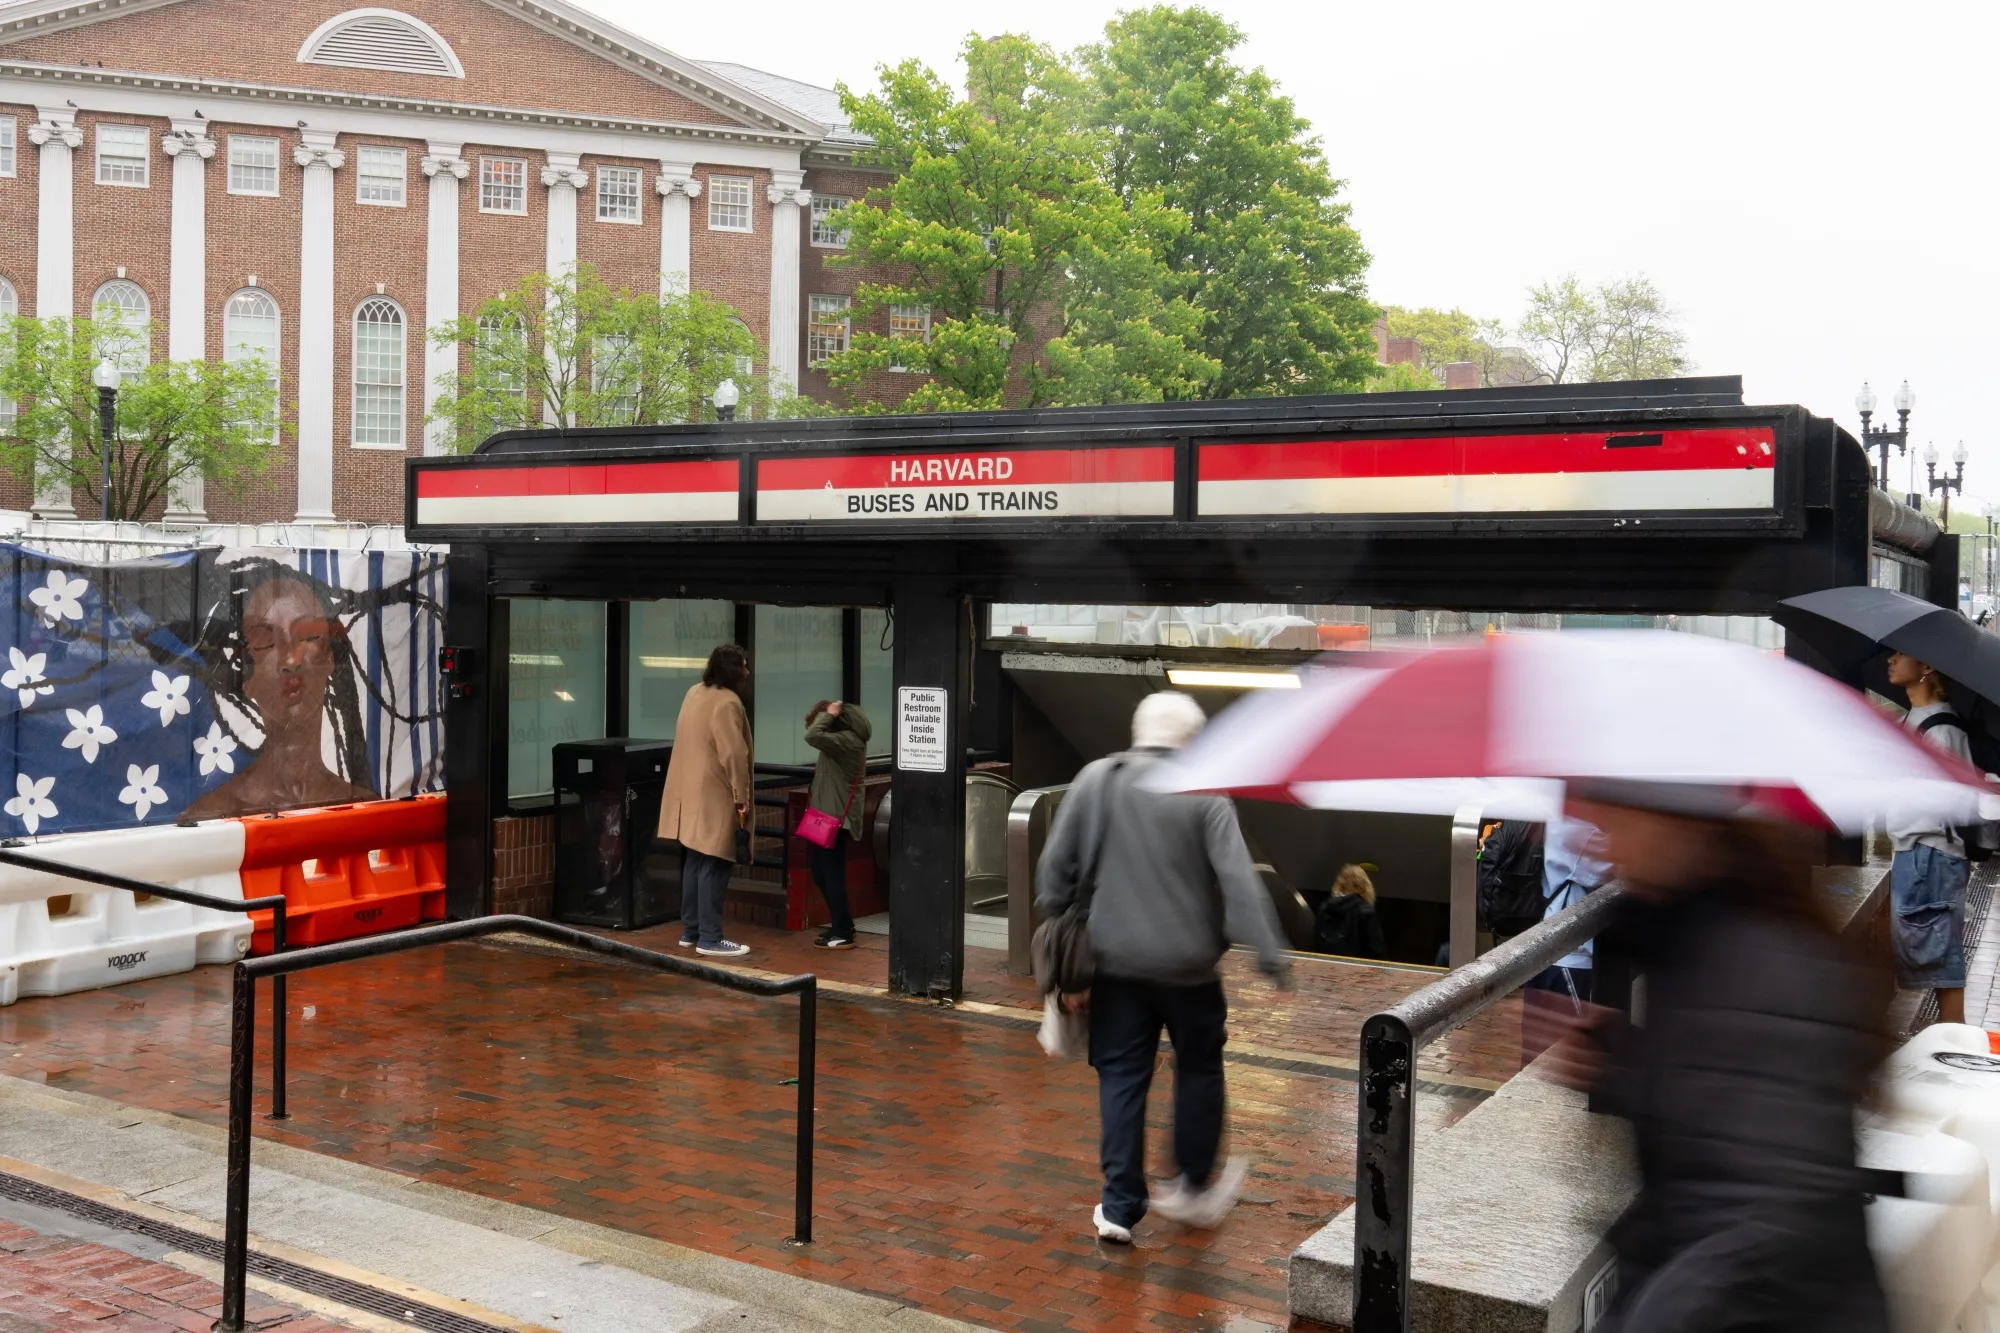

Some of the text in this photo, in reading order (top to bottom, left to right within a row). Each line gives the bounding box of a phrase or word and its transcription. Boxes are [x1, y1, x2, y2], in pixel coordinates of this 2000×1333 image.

[891, 457, 1013, 482] HARVARD
[847, 491, 1059, 513] BUSES AND TRAINS
[911, 693, 935, 702] Public
[904, 703, 941, 713] Restroom
[905, 714, 941, 723] Available
[911, 724, 935, 734] Inside
[909, 735, 937, 744] Station
[108, 951, 147, 968] YODOCK
